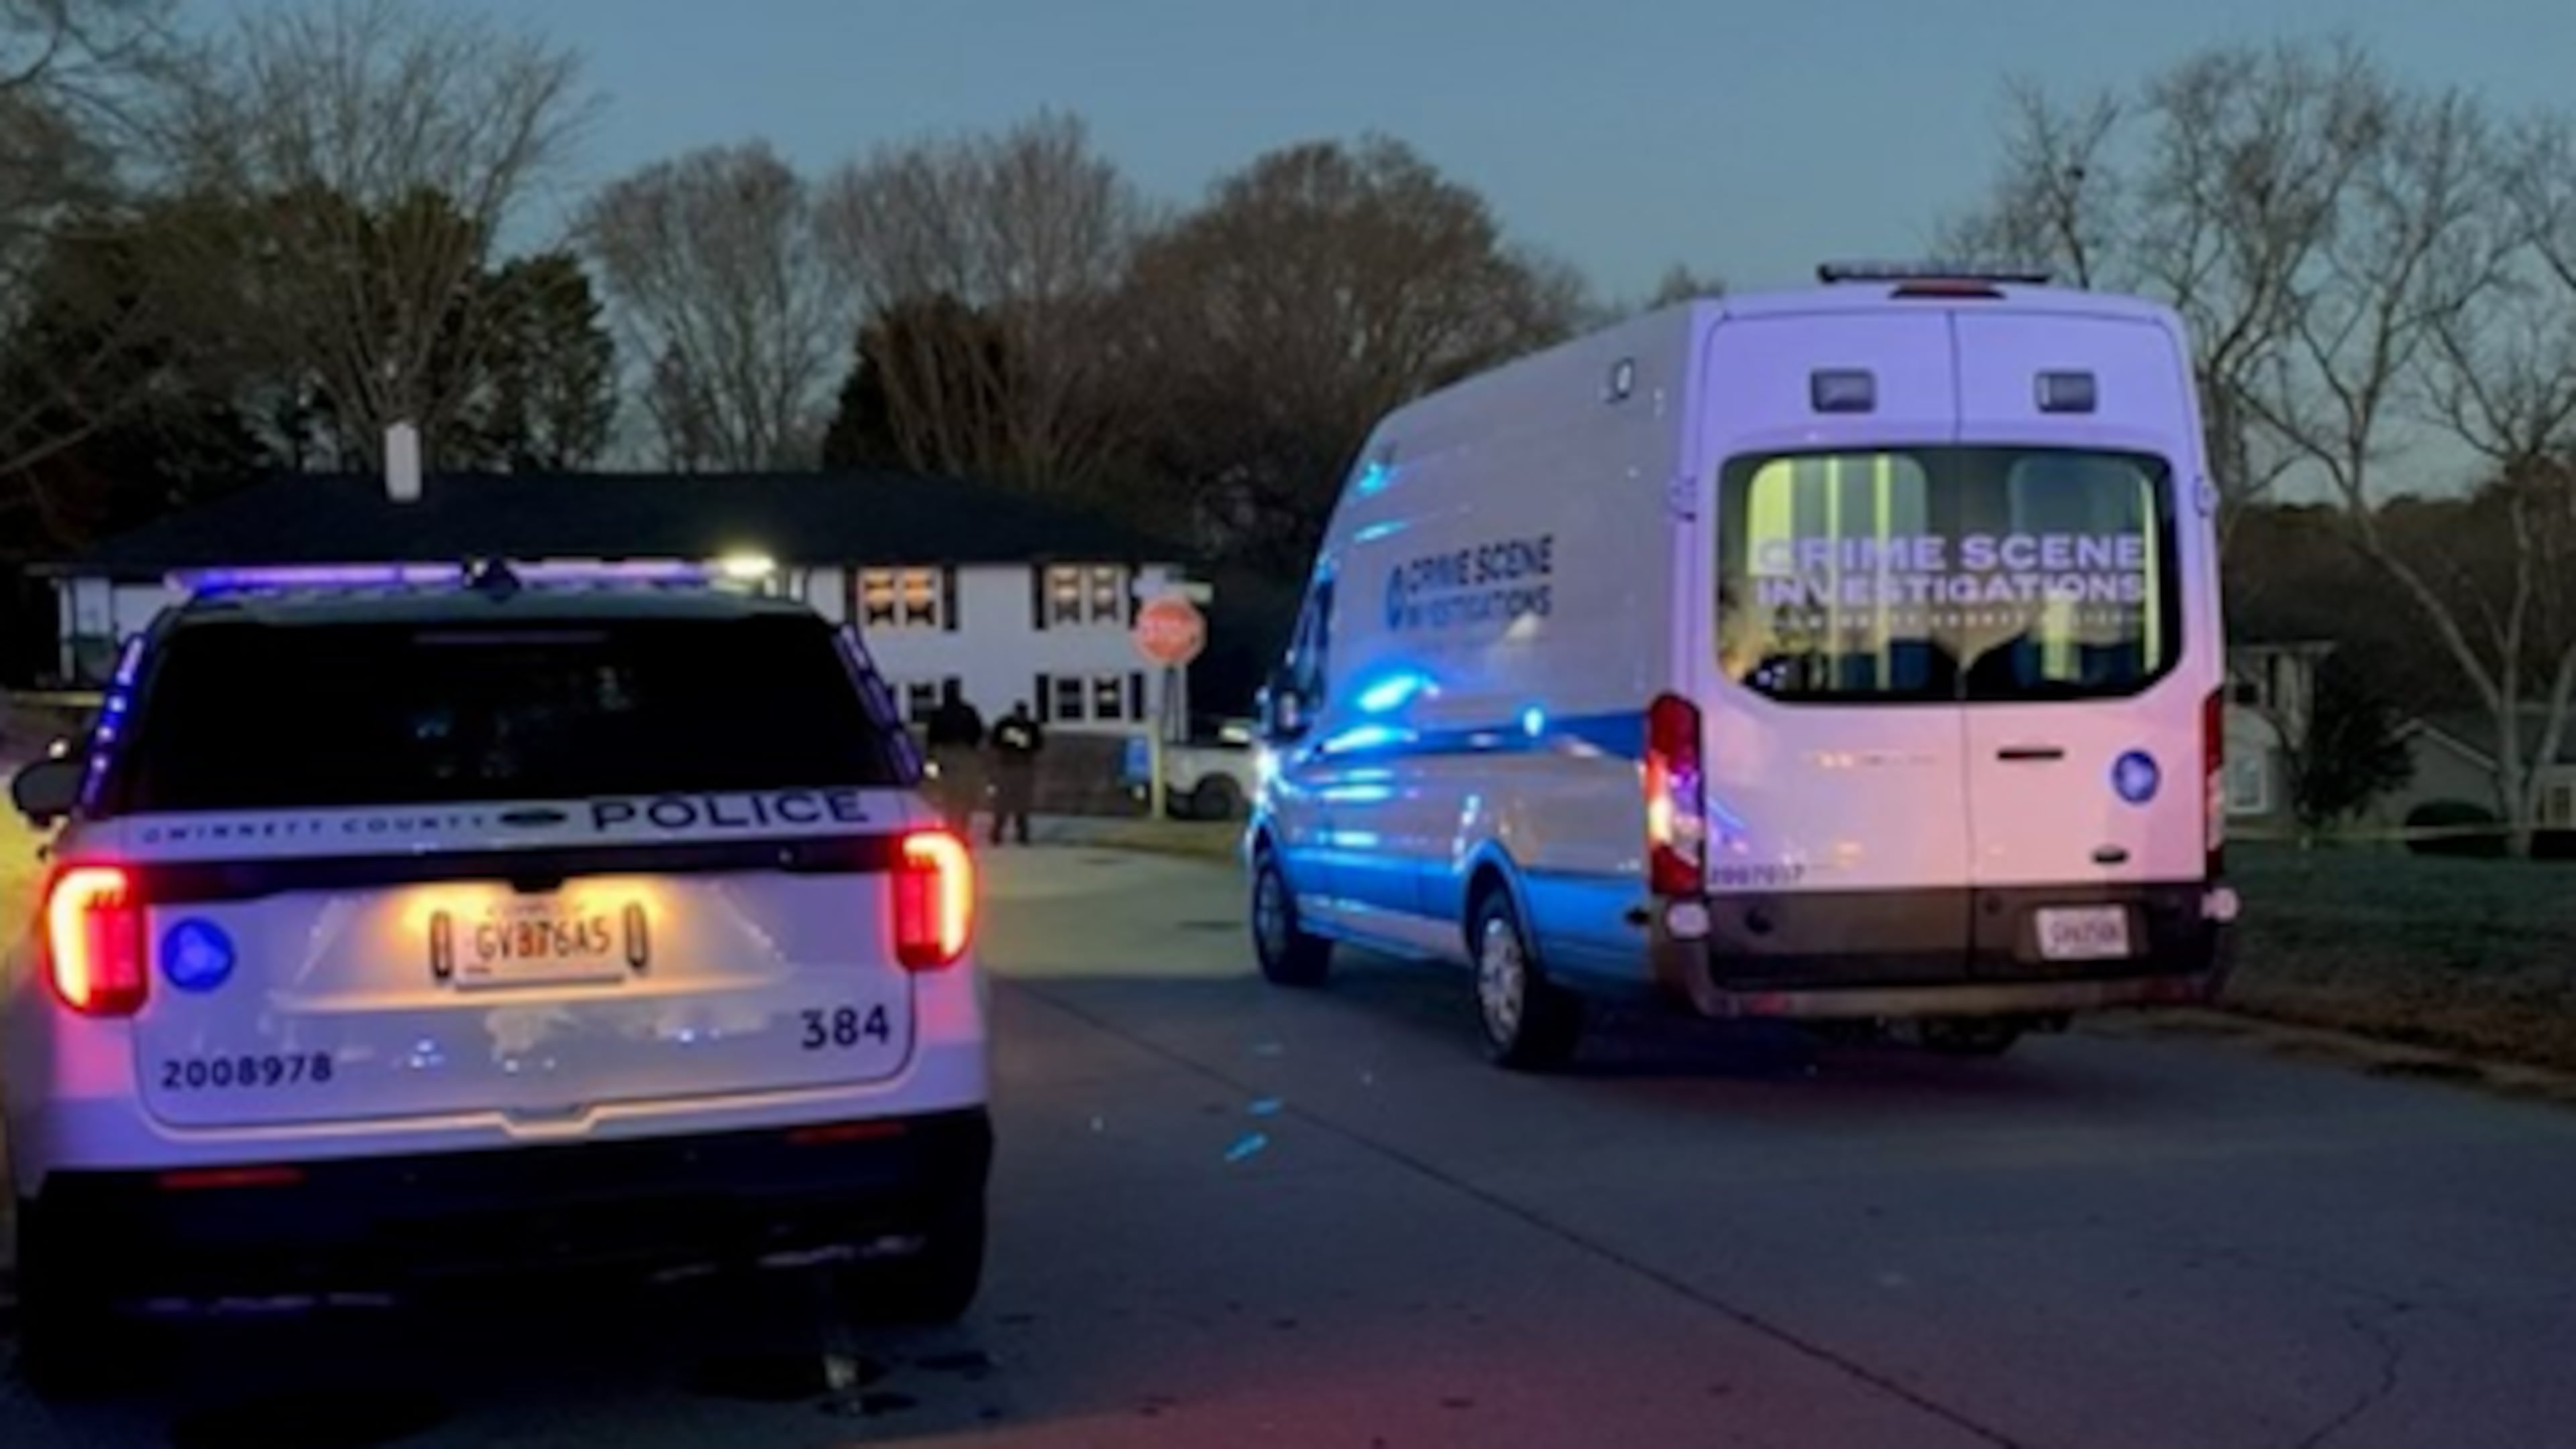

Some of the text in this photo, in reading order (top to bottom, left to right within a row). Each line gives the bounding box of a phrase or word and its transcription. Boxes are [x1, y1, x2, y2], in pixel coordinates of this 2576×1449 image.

[1410, 534, 1552, 593] CRIME SCENE
[1756, 533, 2147, 571] CRIME SCENE
[1755, 572, 2147, 605] INVESTIGATIONS
[341, 814, 484, 835] COUNTY
[591, 792, 869, 830] POLICE
[801, 1005, 890, 1050] 384
[160, 1053, 333, 1090] 2008978
